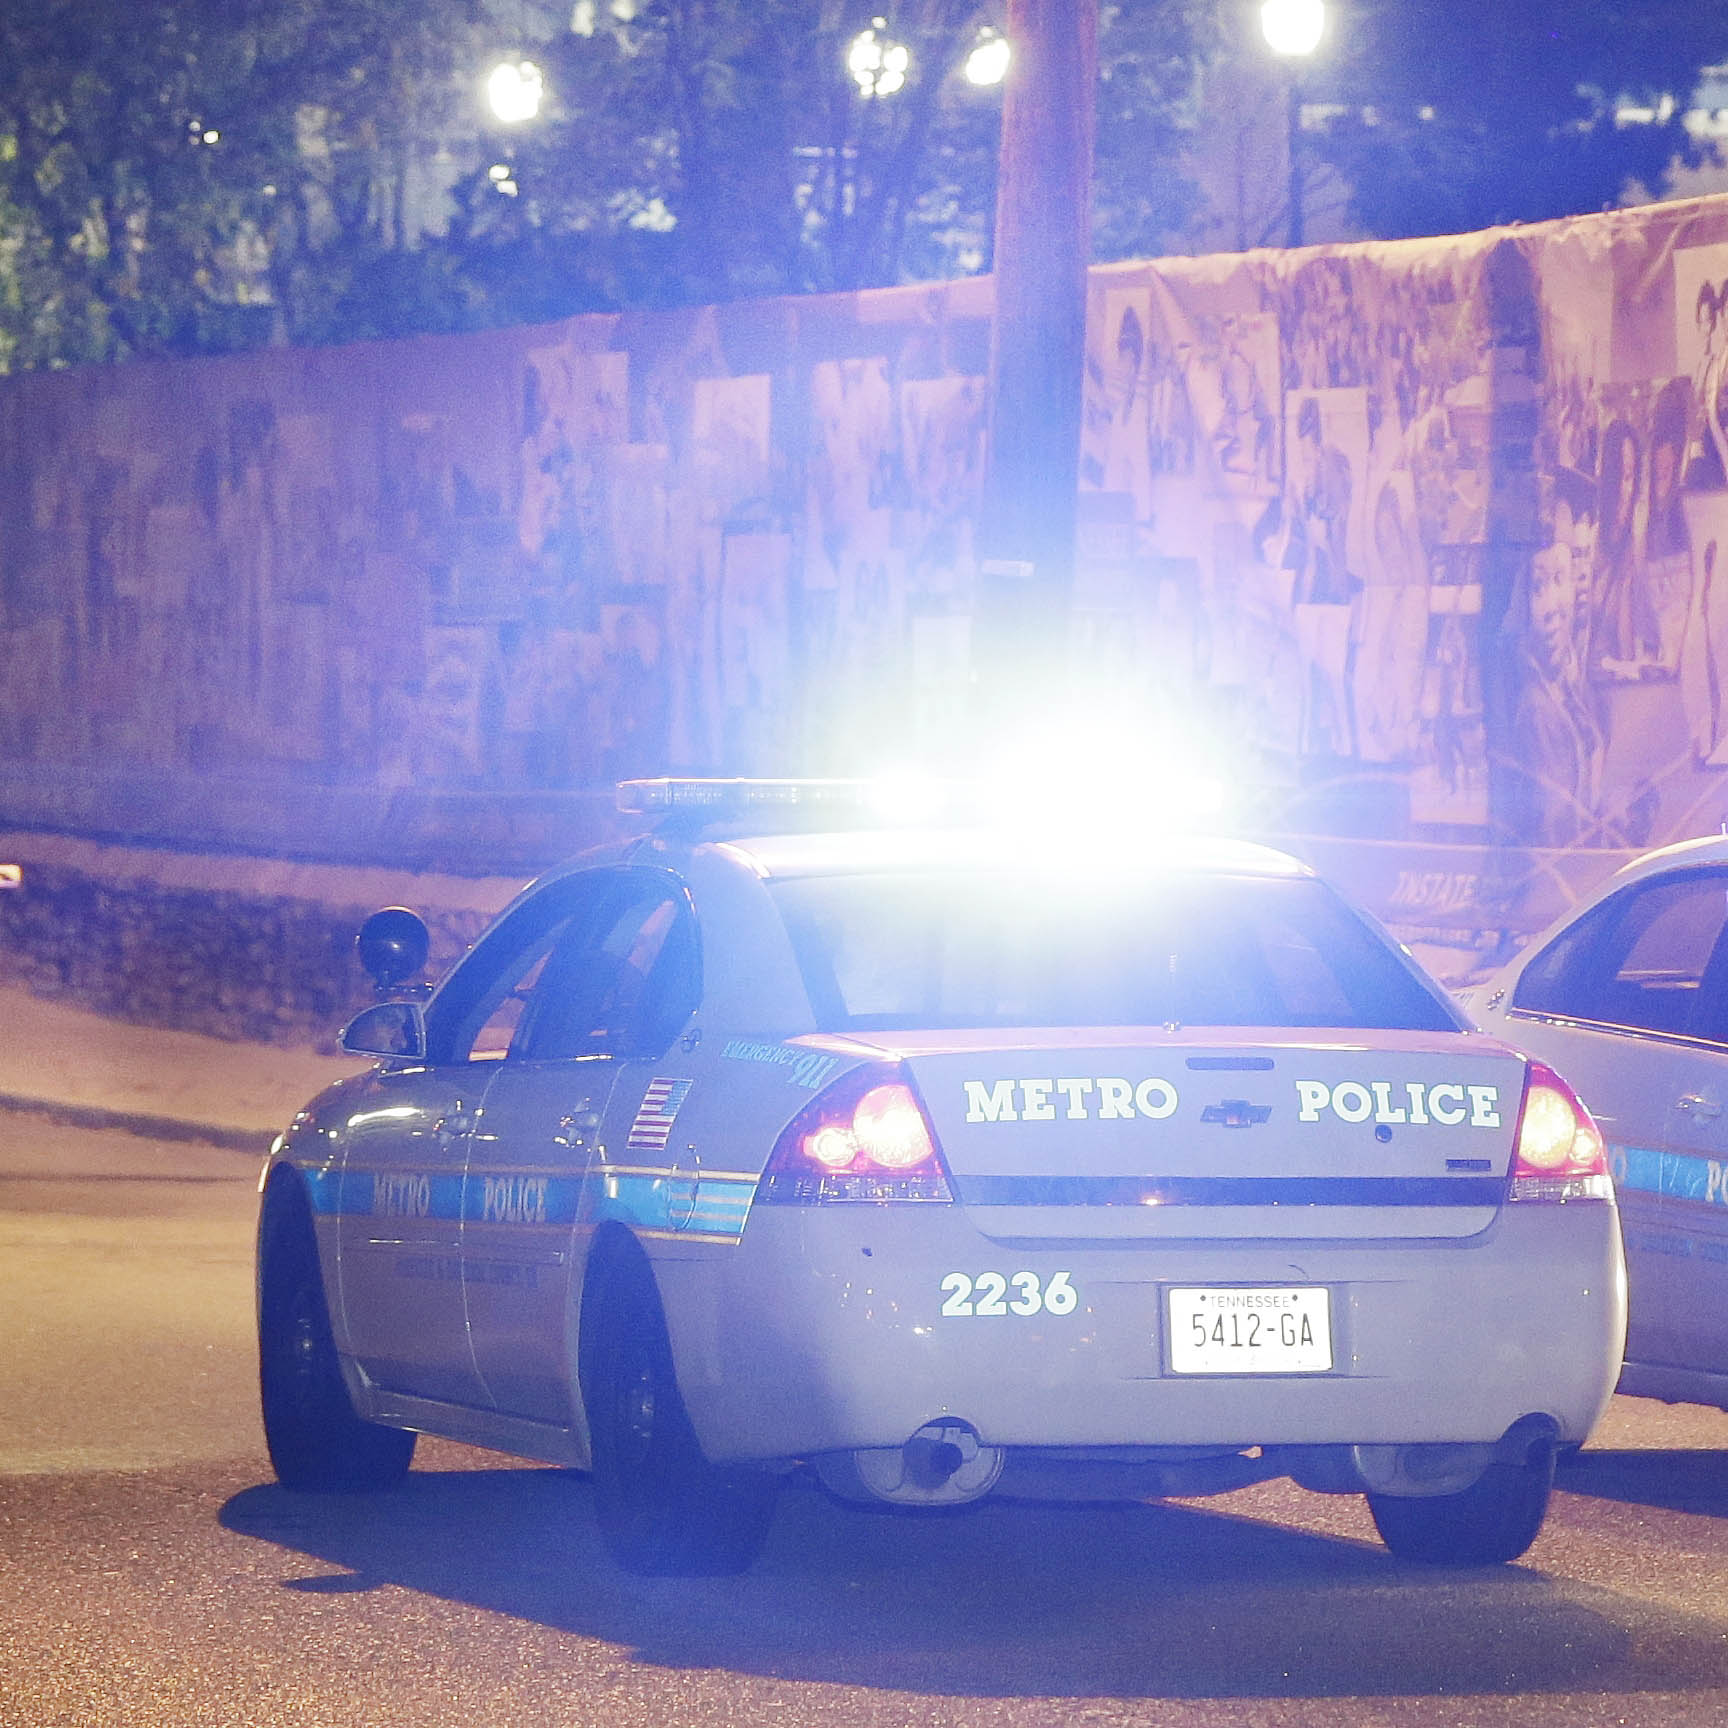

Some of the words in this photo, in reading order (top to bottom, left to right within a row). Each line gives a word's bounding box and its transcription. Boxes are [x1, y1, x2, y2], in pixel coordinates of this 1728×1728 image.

[964, 1077, 1179, 1123] METRO
[1295, 1079, 1502, 1128] POLICE
[374, 1173, 431, 1217] METRO
[483, 1175, 549, 1223] POLICE
[940, 1271, 1079, 1317] 2236
[1209, 1295, 1291, 1308] TENNESSEE
[1192, 1312, 1314, 1348] 5412-GA
